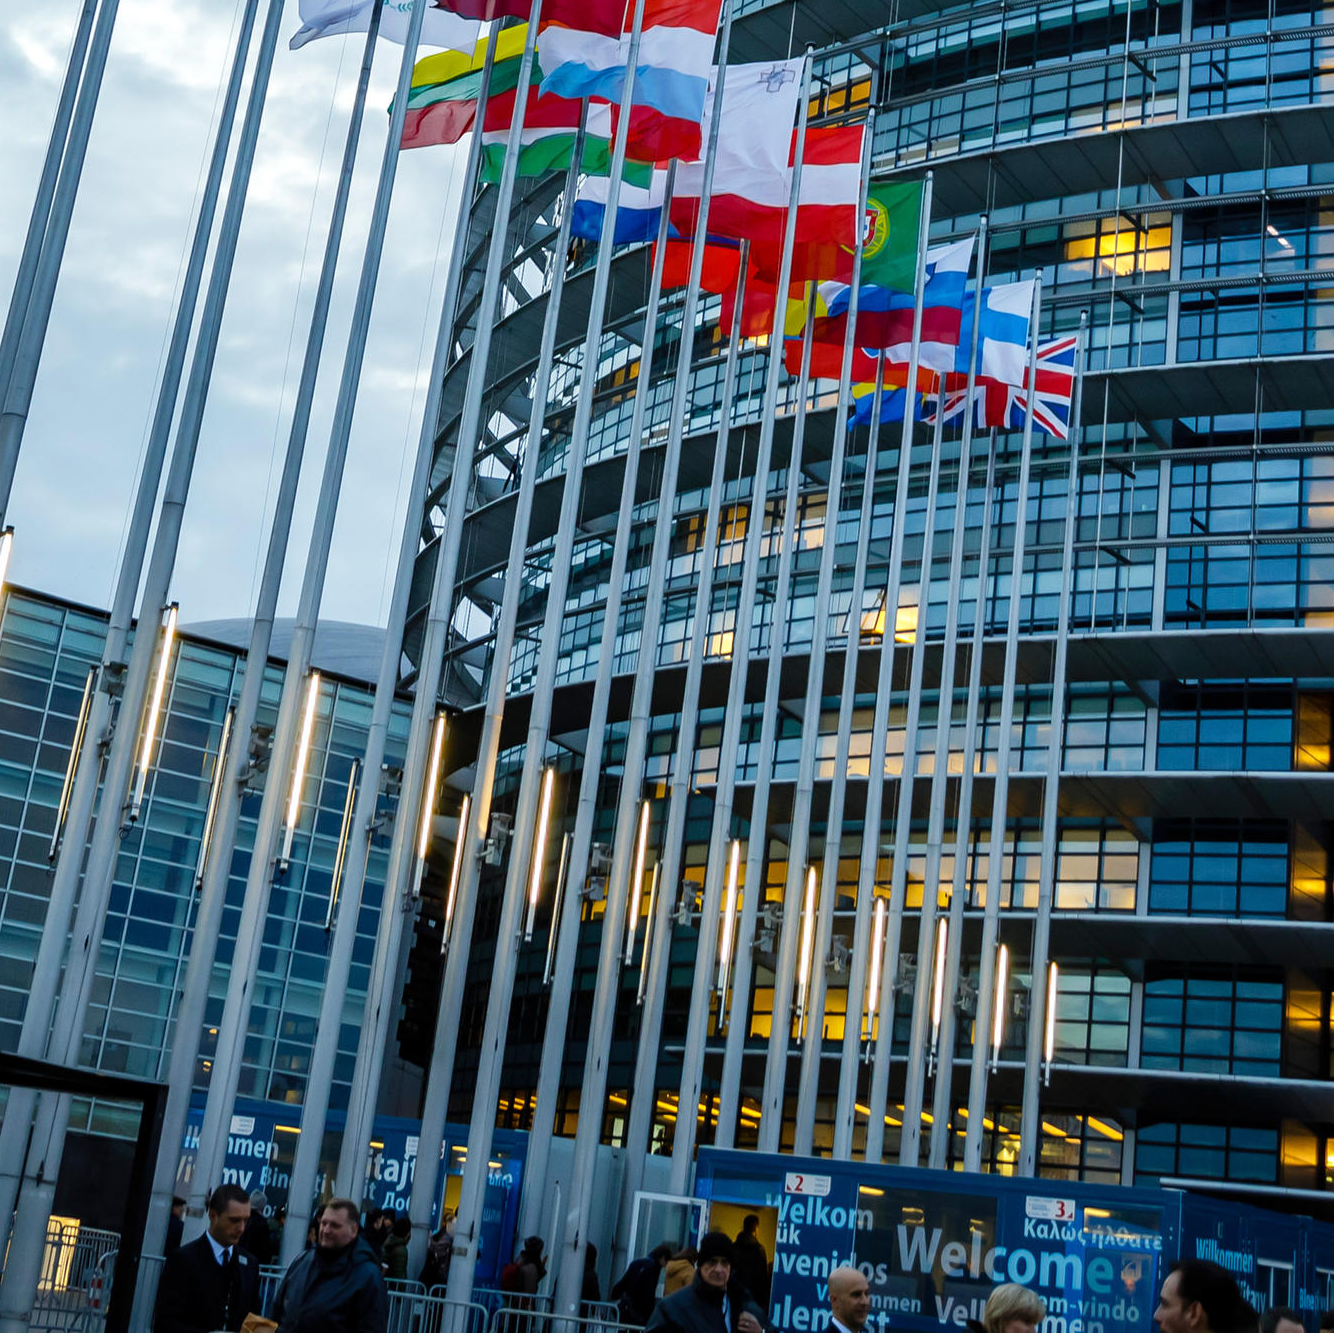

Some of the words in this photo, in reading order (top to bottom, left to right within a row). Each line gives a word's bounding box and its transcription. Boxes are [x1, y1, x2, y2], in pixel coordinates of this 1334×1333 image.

[794, 1174, 804, 1192] 2
[766, 1193, 874, 1231] Welkom
[1055, 1200, 1066, 1218] 3
[897, 1224, 1114, 1294] Welcome
